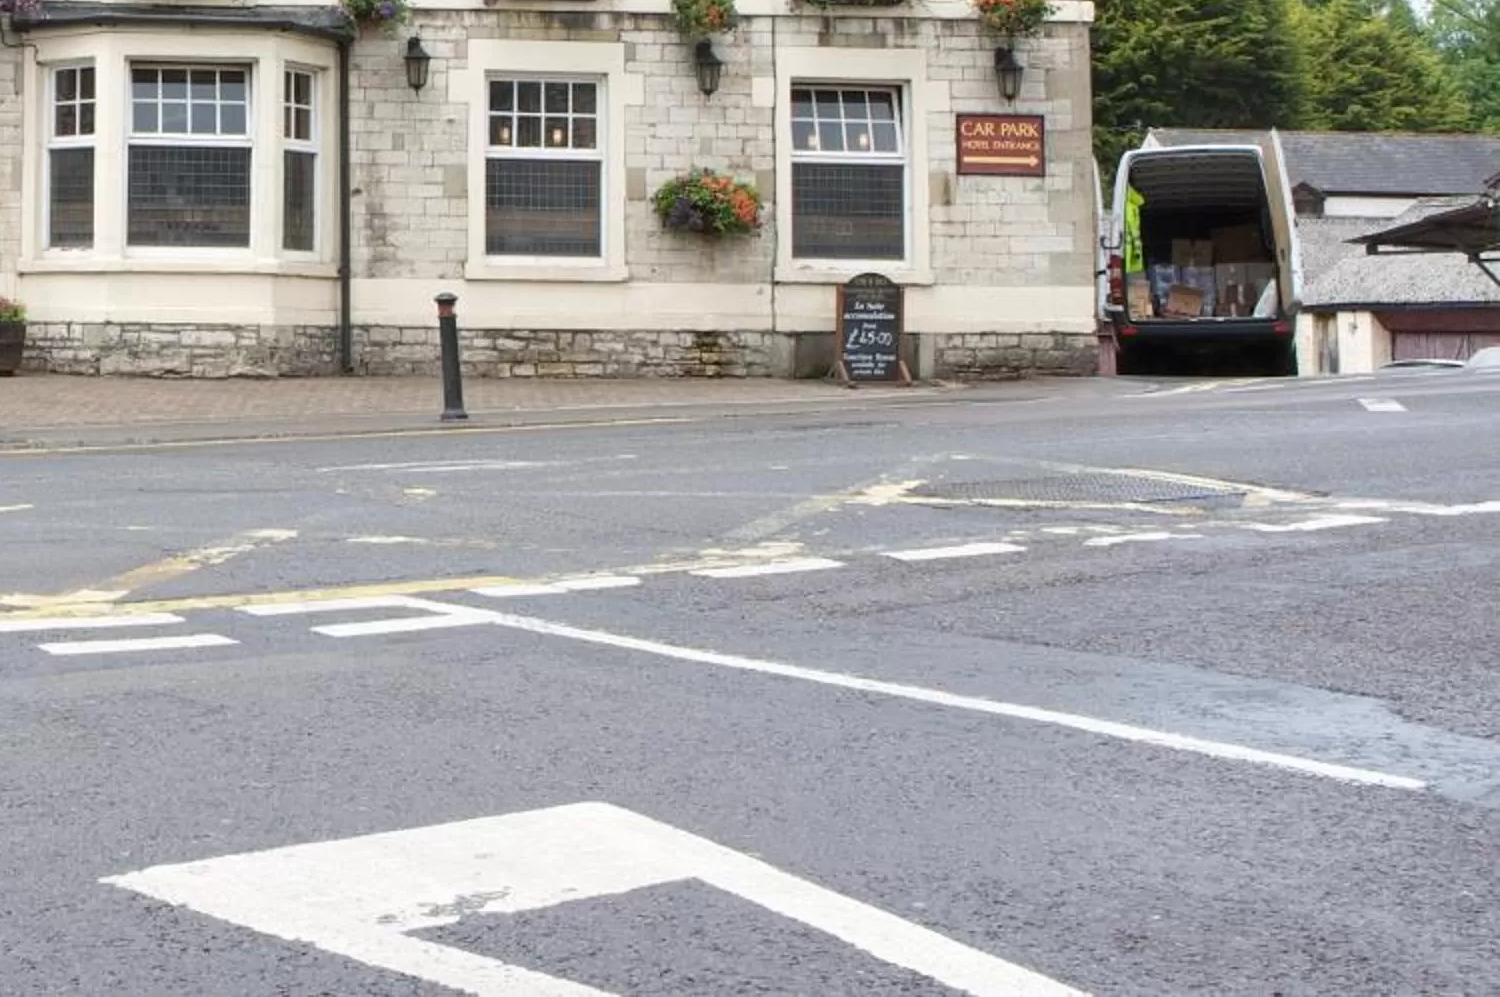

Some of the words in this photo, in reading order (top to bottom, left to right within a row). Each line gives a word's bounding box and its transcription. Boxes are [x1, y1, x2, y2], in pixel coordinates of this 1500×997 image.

[961, 120, 995, 136] CAR
[1001, 122, 1039, 137] PARK
[962, 141, 989, 151] HOTEL
[993, 141, 1040, 152] ENTRANCE
